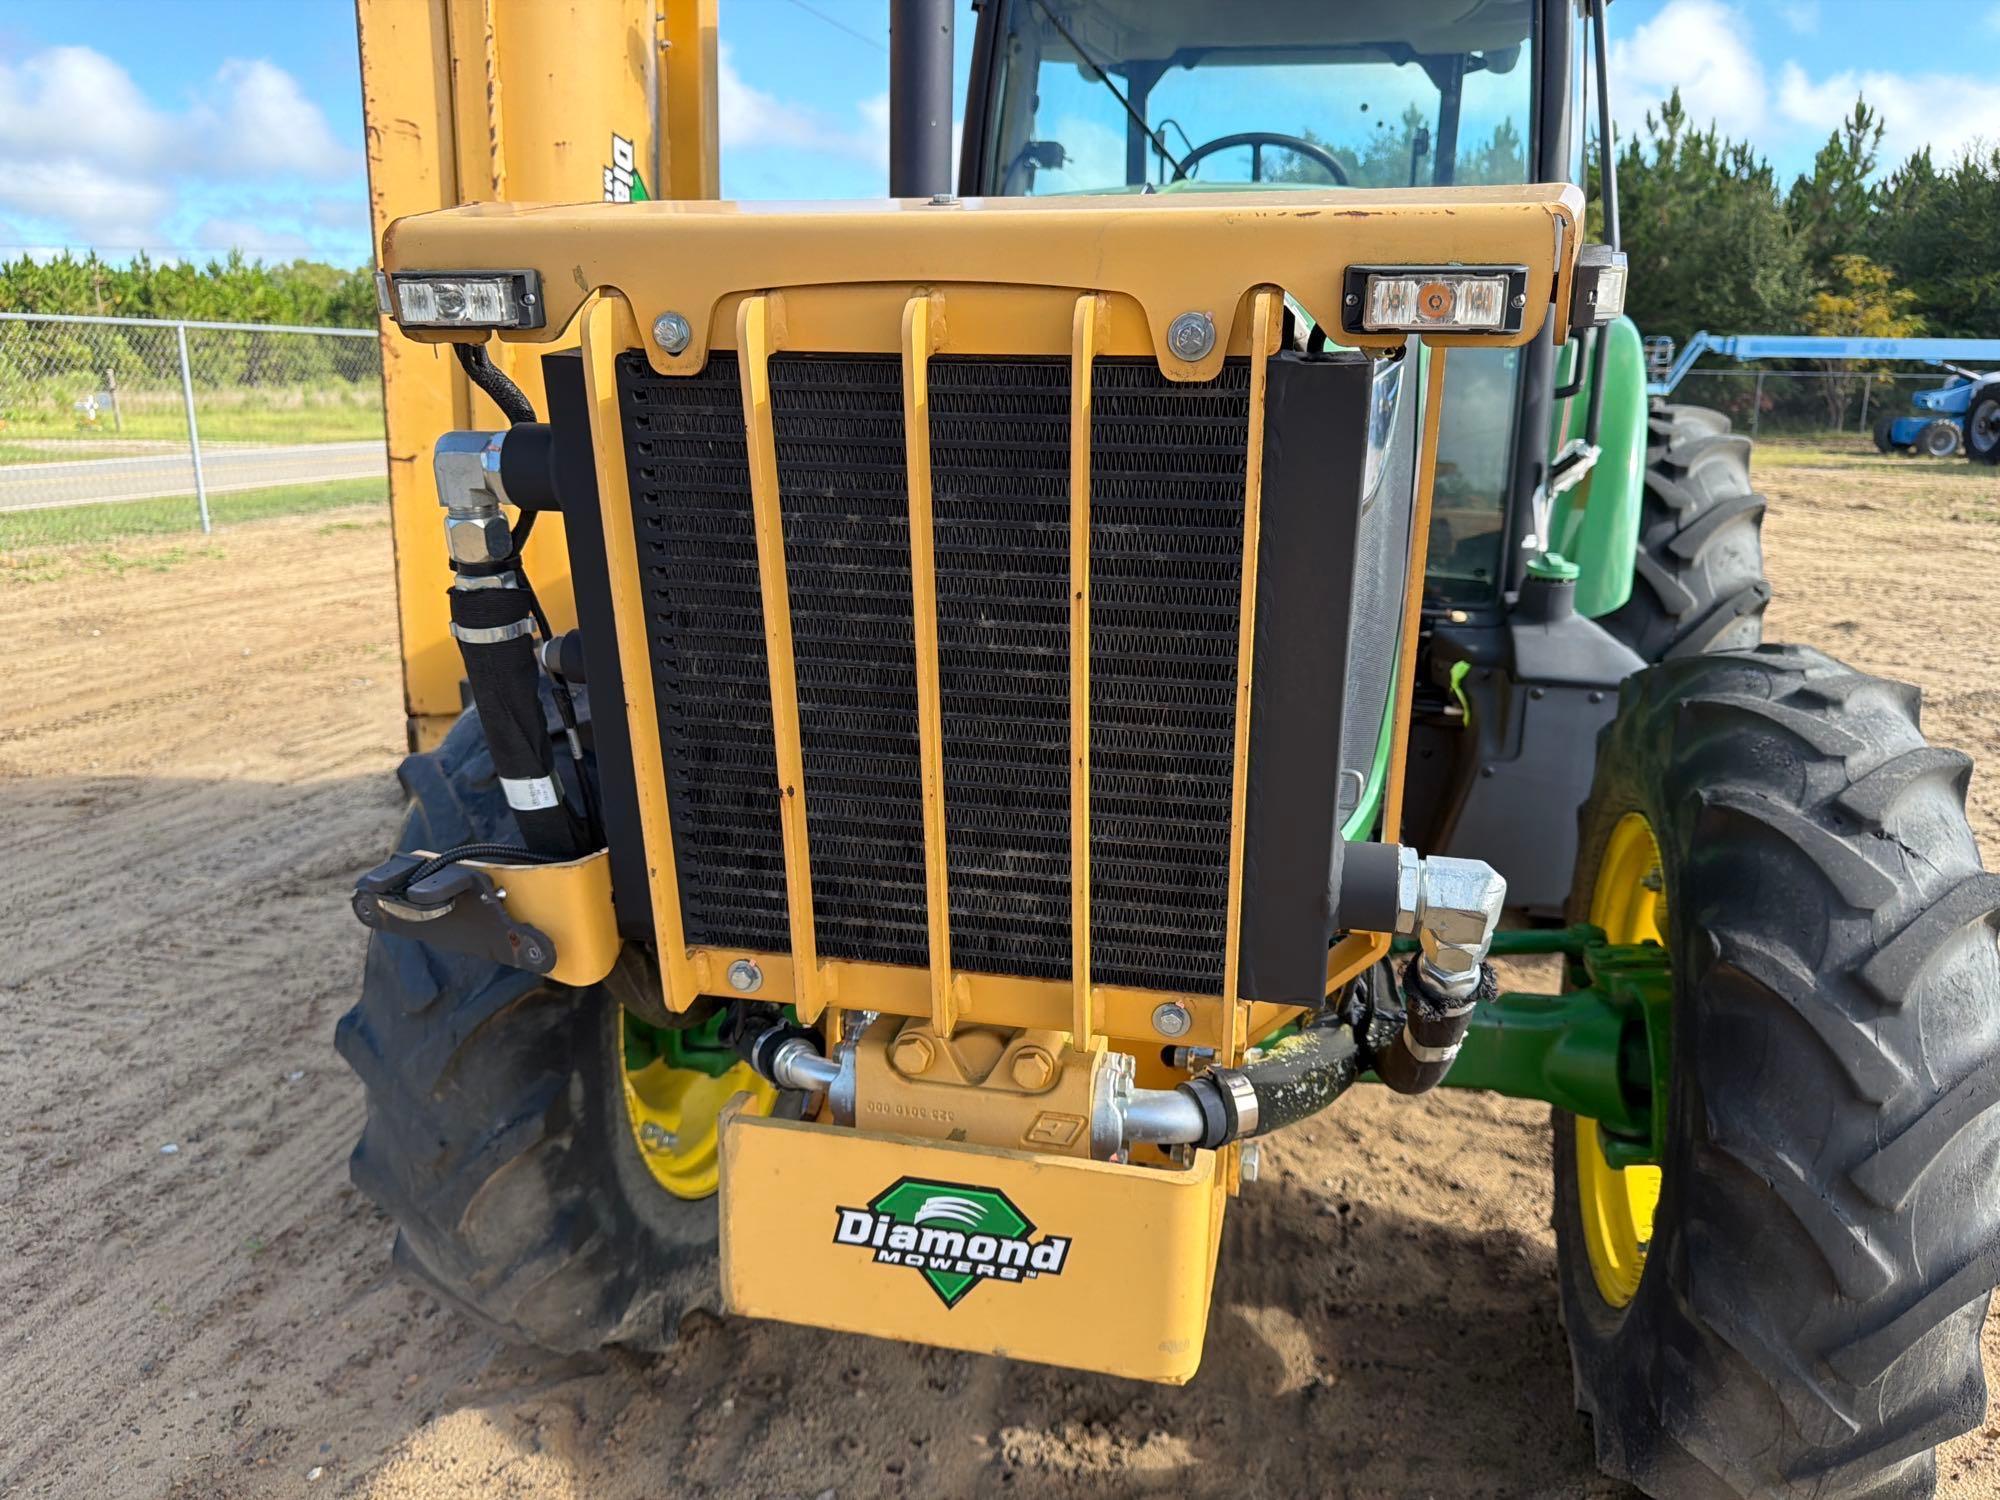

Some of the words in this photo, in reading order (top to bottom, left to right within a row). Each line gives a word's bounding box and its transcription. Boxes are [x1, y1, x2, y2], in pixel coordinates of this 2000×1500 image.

[612, 133, 635, 202] Dia
[837, 1210, 1067, 1272] Diamond
[877, 1250, 1020, 1280] MOWERS
